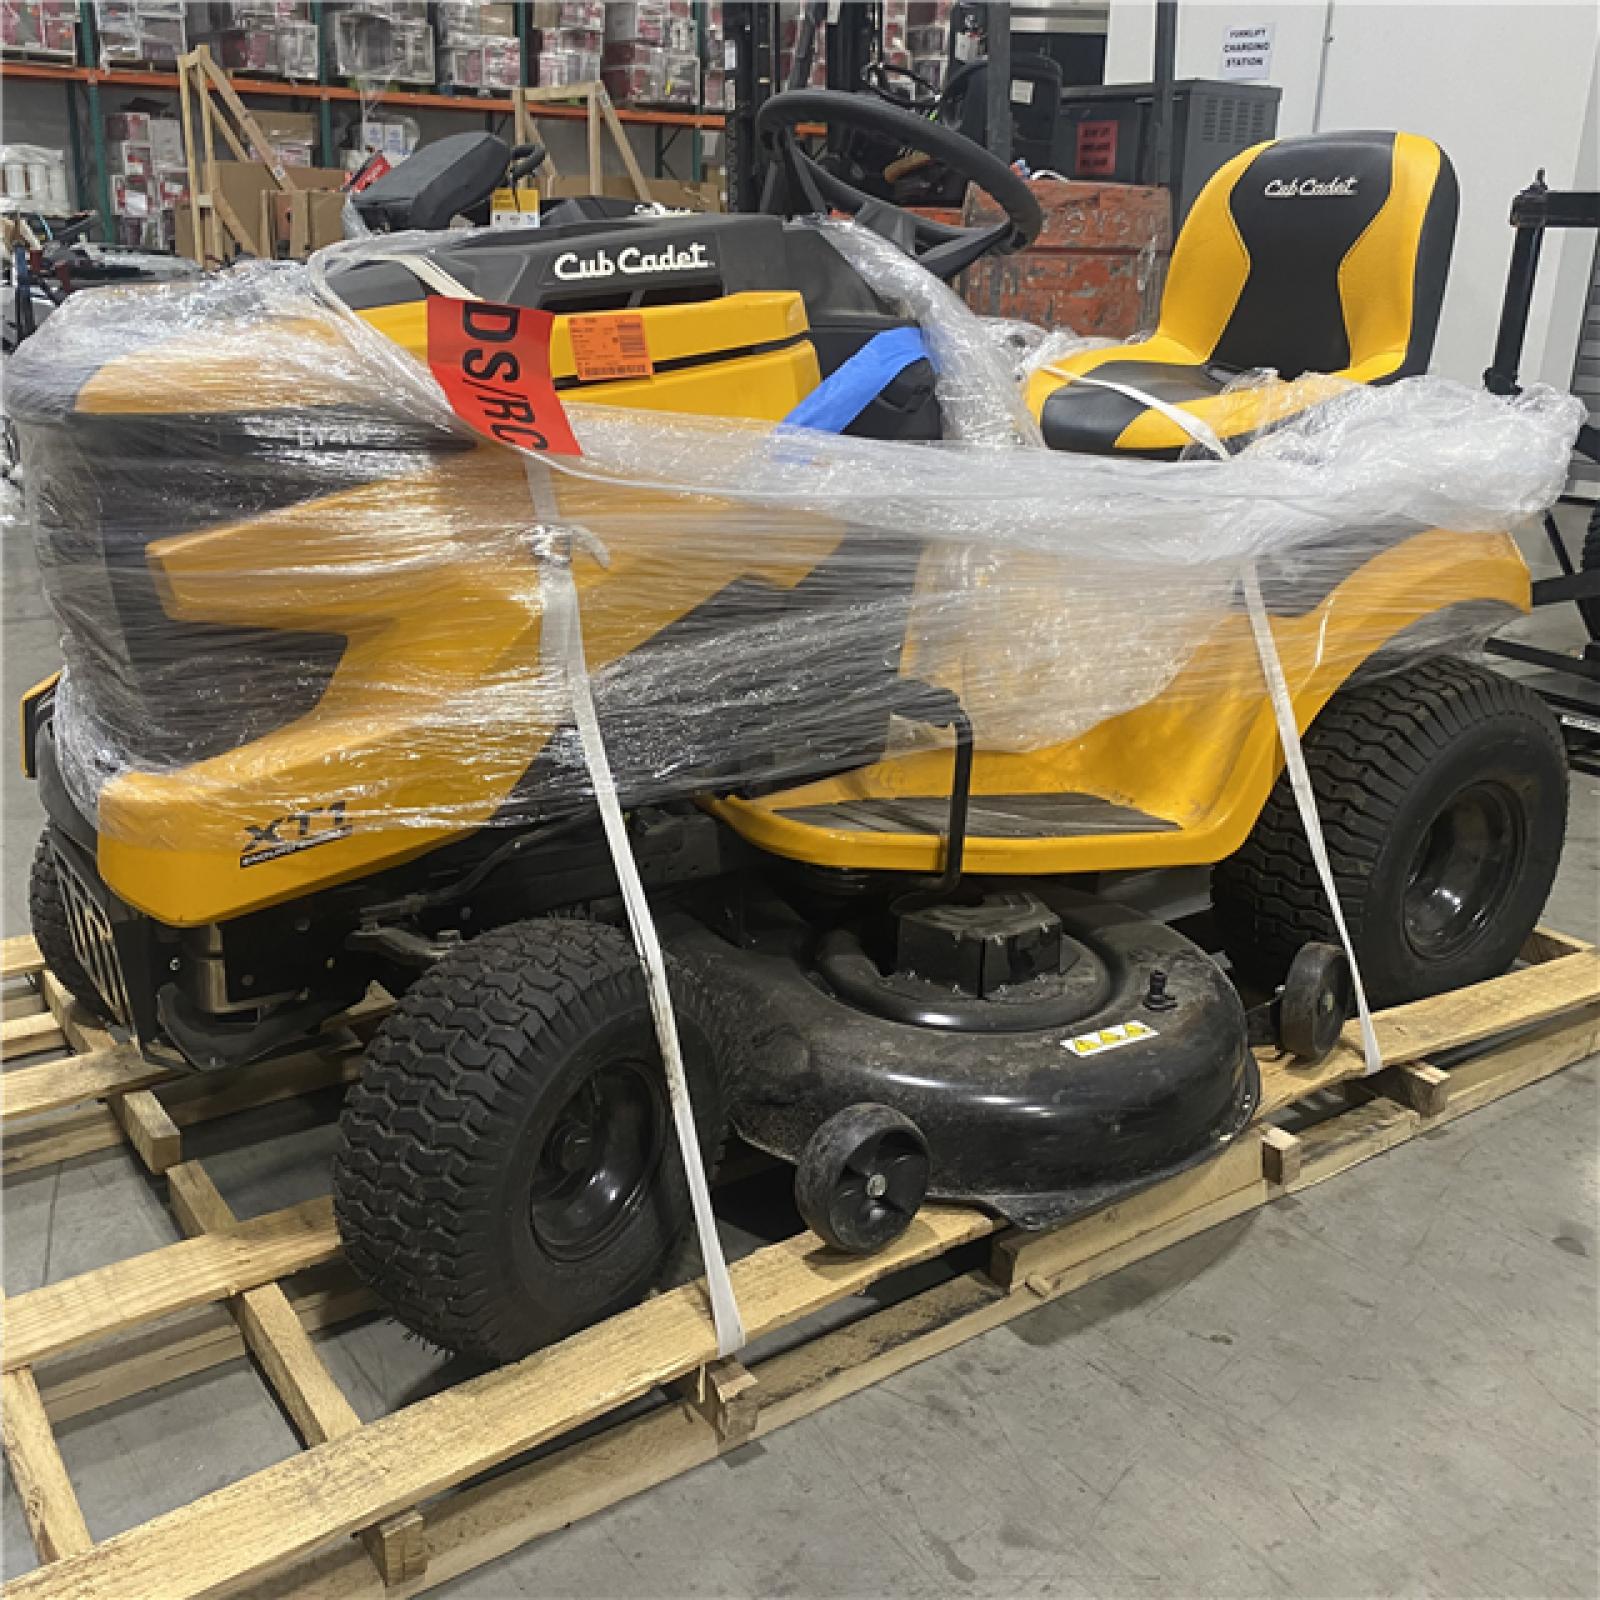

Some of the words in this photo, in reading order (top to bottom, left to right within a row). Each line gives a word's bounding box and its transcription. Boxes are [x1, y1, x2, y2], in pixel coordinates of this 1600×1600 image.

[1223, 42, 1270, 52] CHARGING
[1224, 57, 1264, 68] STATION
[554, 250, 616, 280] Cub
[617, 241, 710, 274] Cadet
[242, 799, 346, 852] XT1
